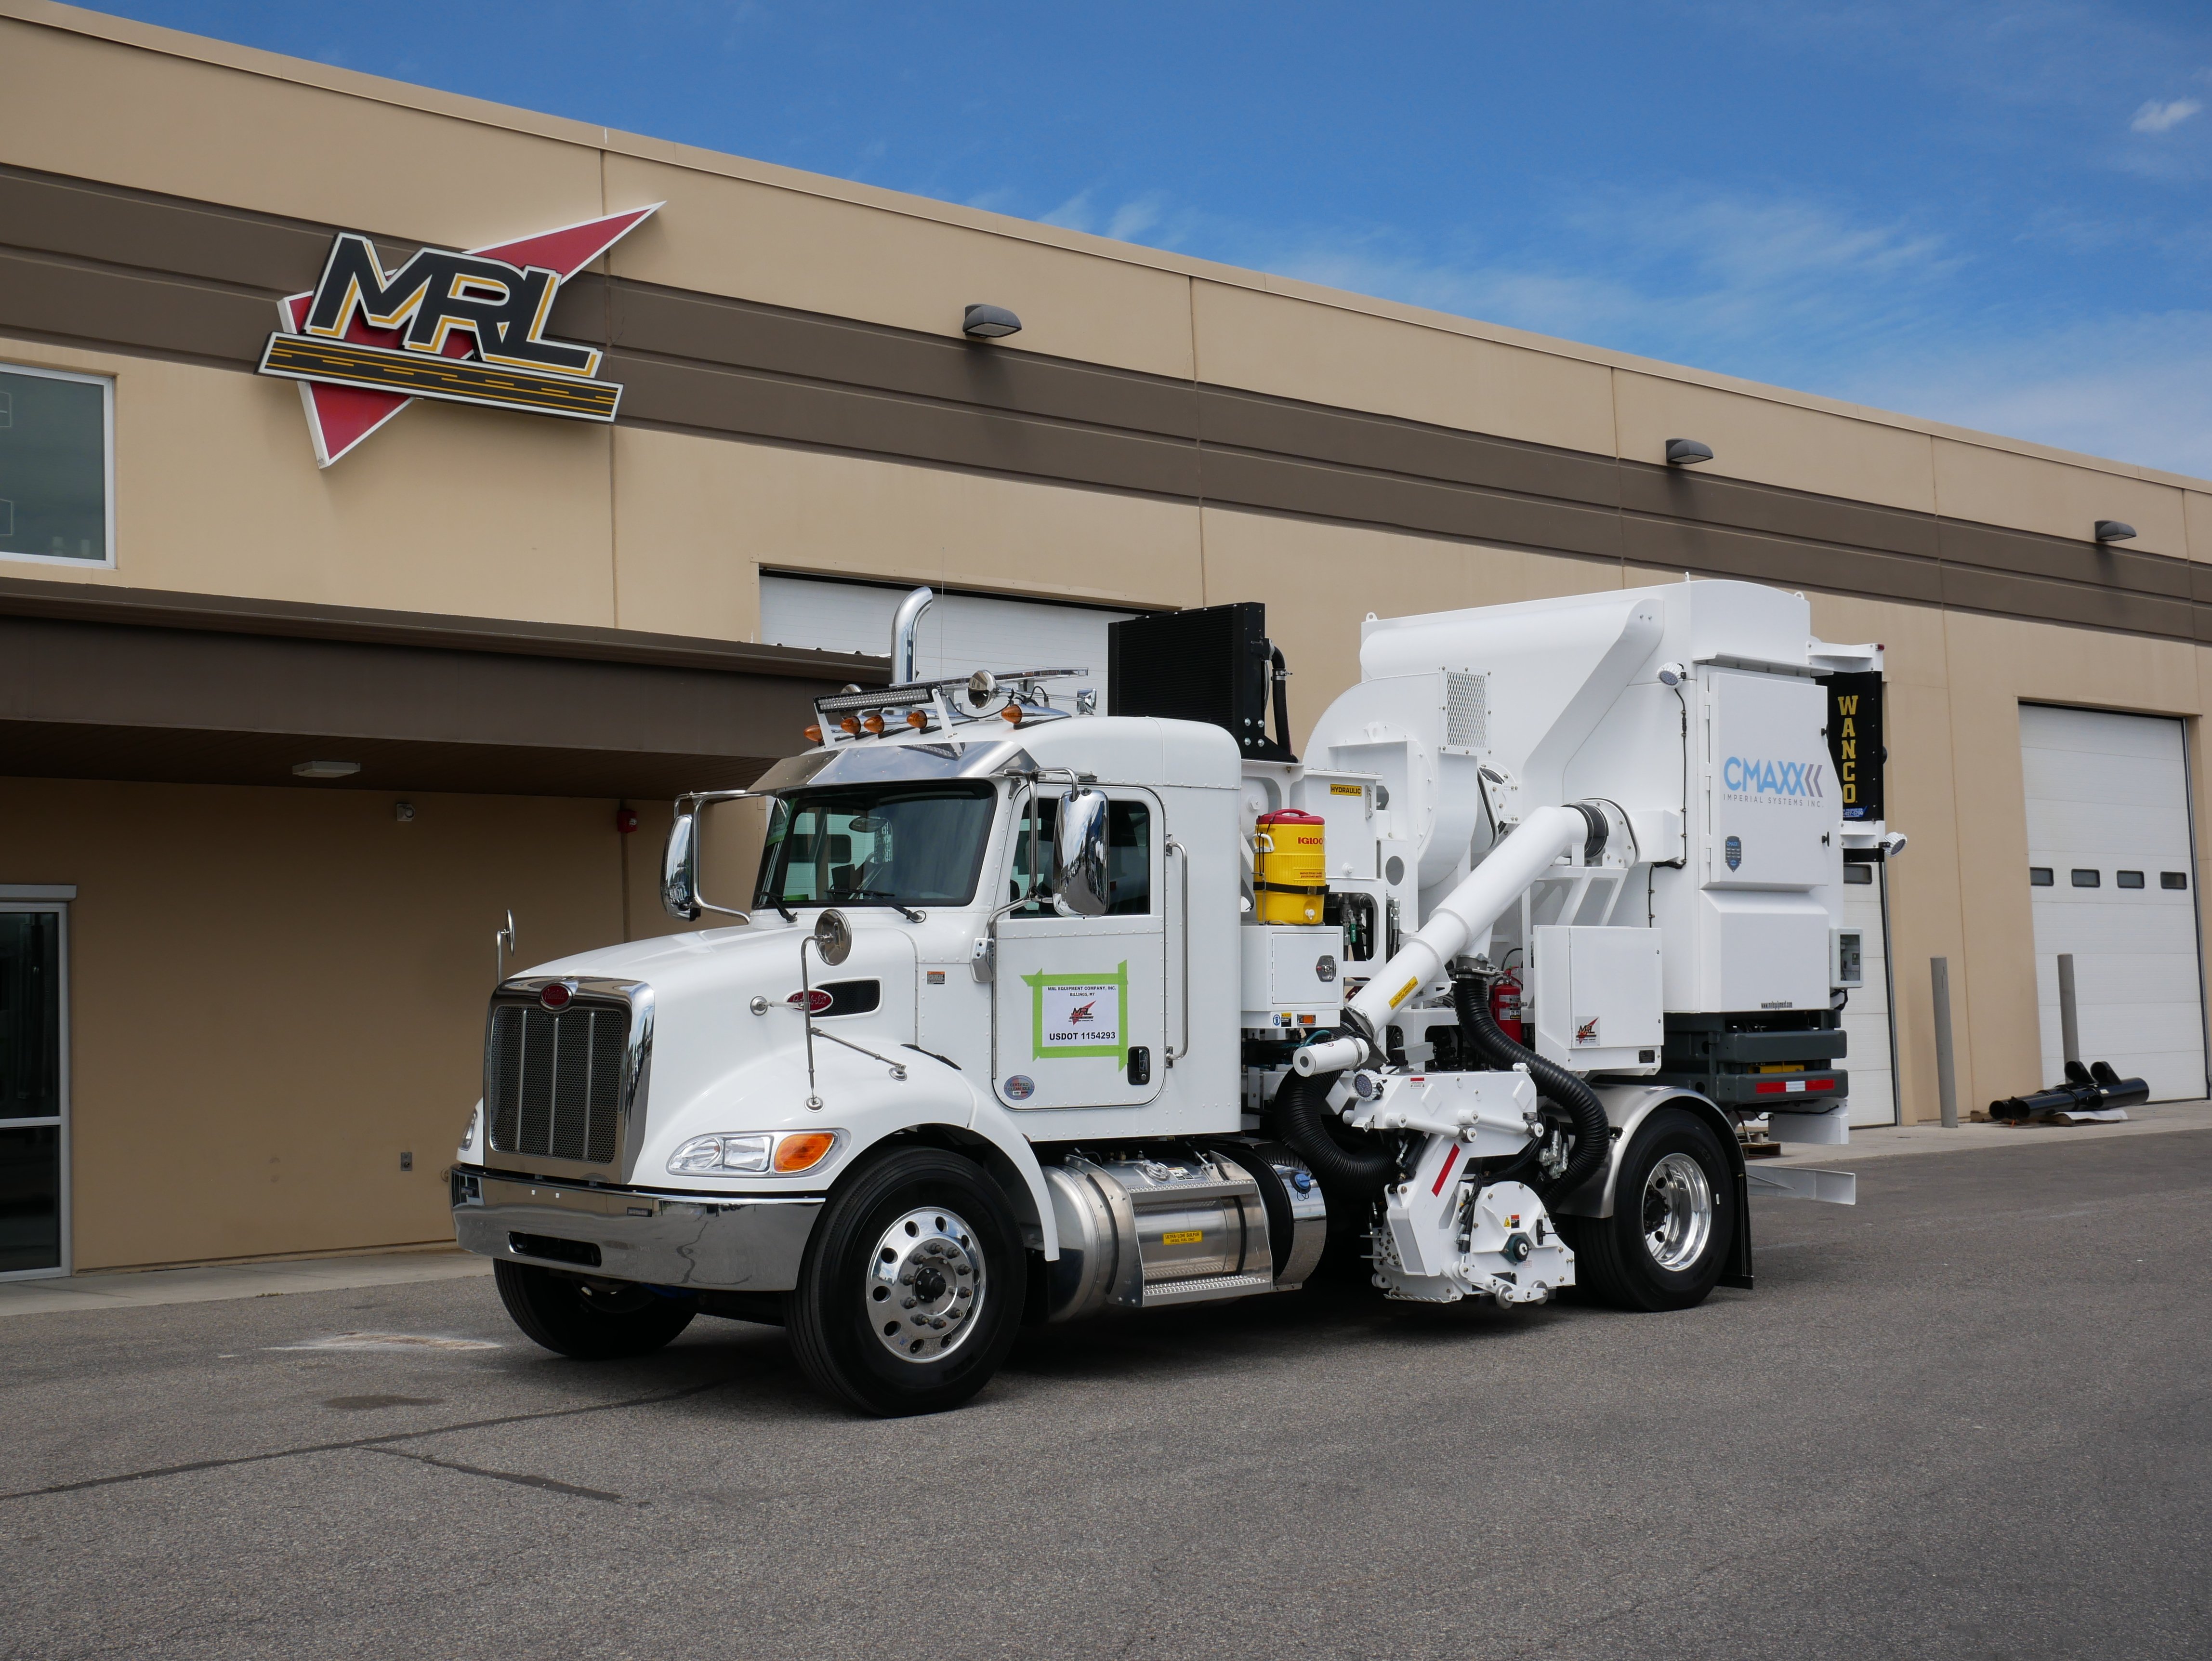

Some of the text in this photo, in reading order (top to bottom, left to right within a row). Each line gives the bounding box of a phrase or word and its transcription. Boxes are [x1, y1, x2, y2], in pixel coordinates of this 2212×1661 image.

[303, 232, 604, 378] MRL
[1838, 695, 1858, 803] WANCO
[1724, 756, 1806, 796] CMAXX
[1331, 786, 1361, 794] HYDRAULIC
[1723, 794, 1763, 803] IMPERIAL
[1768, 797, 1803, 806] SYSTEMS
[1072, 1007, 1092, 1015] MRL
[1578, 1025, 1595, 1034] MRL
[1081, 1031, 1116, 1040] 1154293
